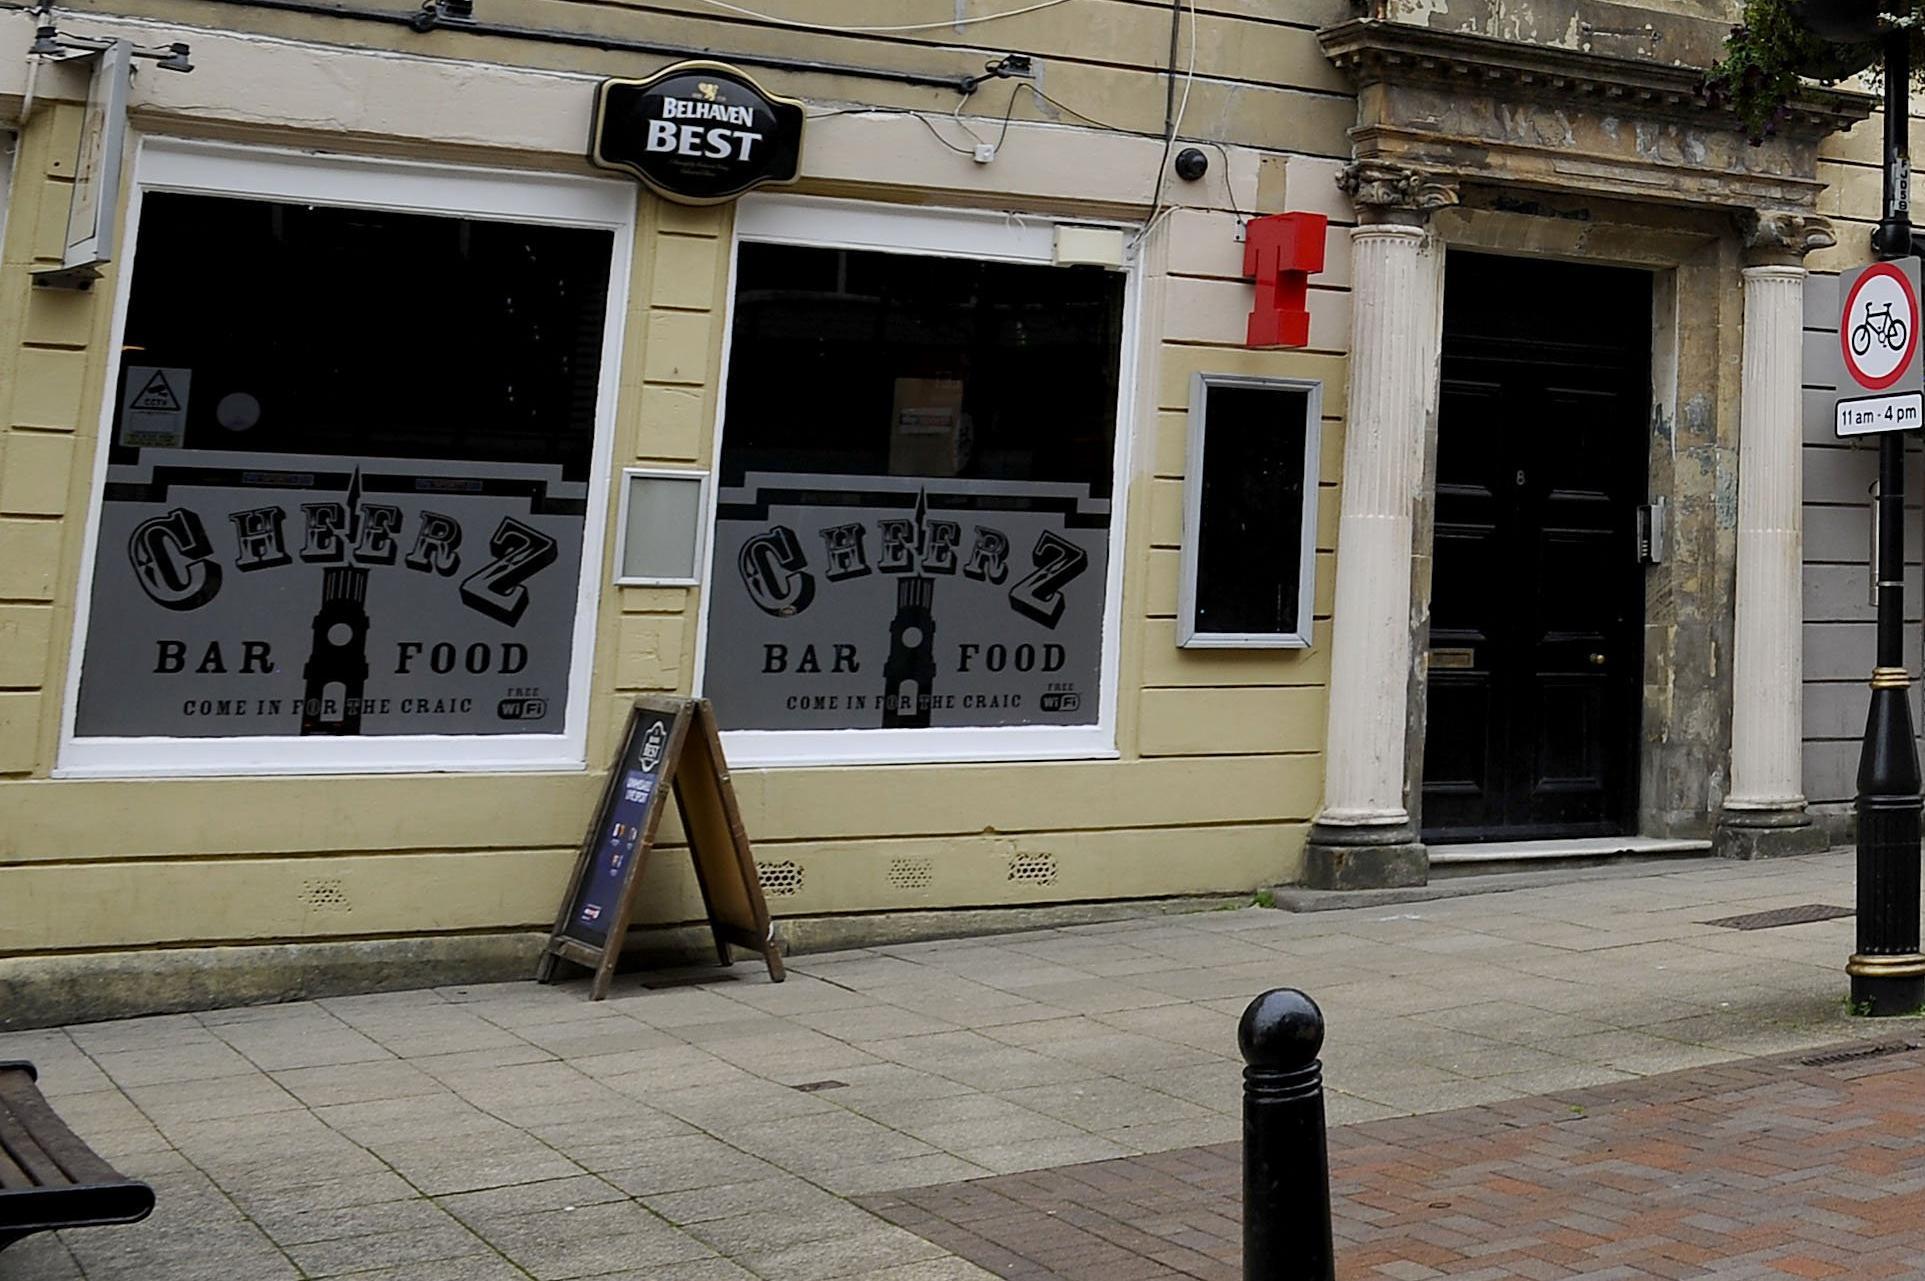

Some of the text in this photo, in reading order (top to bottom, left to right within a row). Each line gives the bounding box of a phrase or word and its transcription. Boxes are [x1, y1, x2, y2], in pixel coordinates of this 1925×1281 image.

[662, 97, 754, 127] BELHAVEN
[646, 119, 763, 161] BEST
[1842, 409, 1852, 426] 11
[1856, 411, 1874, 424] am
[1884, 405, 1893, 421] 4
[1897, 407, 1917, 423] pm
[128, 502, 558, 628] CHEERZ
[738, 519, 1088, 629] CHEERZ
[153, 640, 529, 674] BAR FOOD
[762, 643, 1066, 673] BAR FOOD
[507, 687, 540, 697] FREE
[1048, 682, 1075, 692] FREE
[183, 698, 472, 716] COME IN FOR THE CRAIC
[786, 694, 1022, 711] COME IN FOR THE CRAIC
